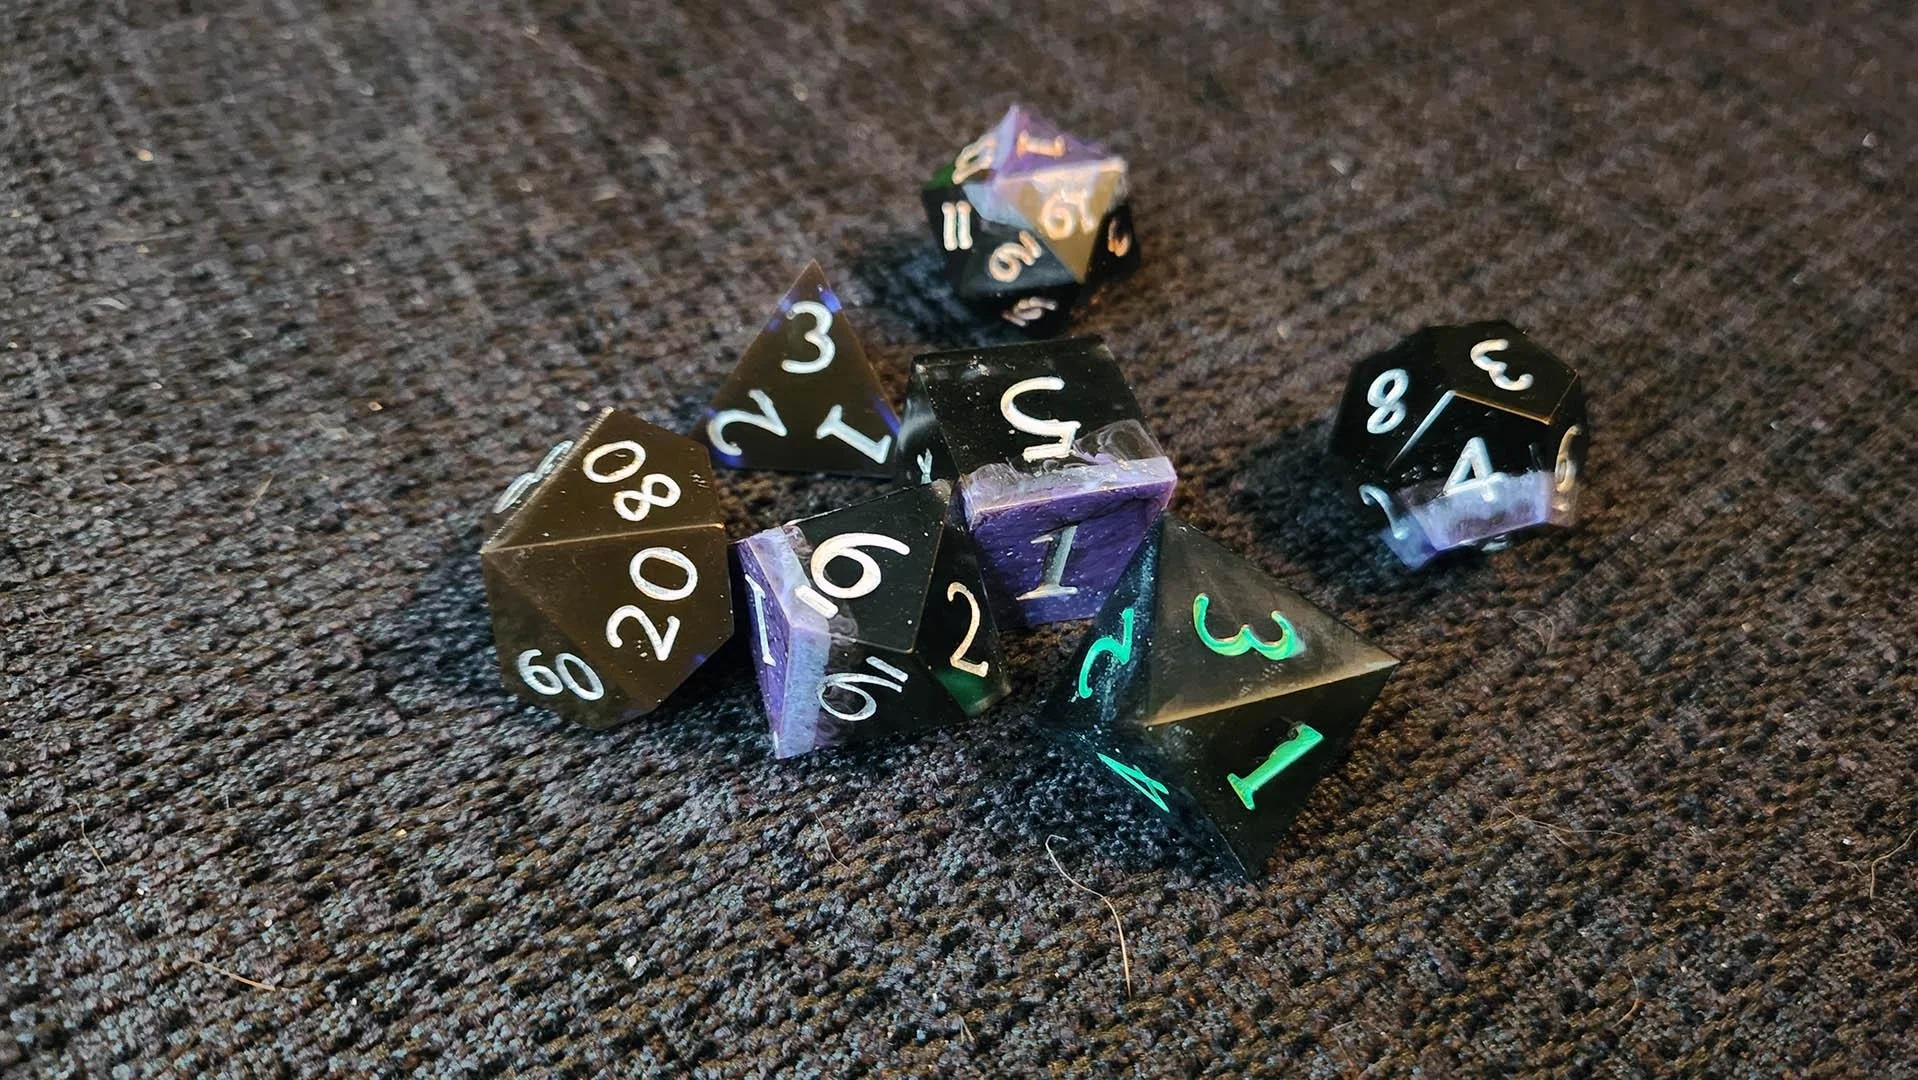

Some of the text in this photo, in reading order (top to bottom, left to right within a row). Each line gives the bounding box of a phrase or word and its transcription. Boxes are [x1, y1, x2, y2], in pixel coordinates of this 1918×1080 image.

[941, 200, 973, 251] 11
[781, 300, 836, 374] 3
[1470, 338, 1534, 391] 3
[706, 389, 788, 456] 2
[816, 404, 892, 465] 1
[1000, 376, 1082, 463] 5
[1367, 368, 1410, 434] 8
[582, 440, 682, 522] 80
[1443, 436, 1506, 502] 4
[1016, 524, 1079, 600] 1
[605, 547, 698, 662] 20
[744, 573, 776, 667] 1
[946, 581, 990, 677] 2
[1193, 592, 1300, 660] 3
[517, 649, 605, 701] 60
[1078, 608, 1134, 699] 2
[1227, 723, 1324, 810] 1
